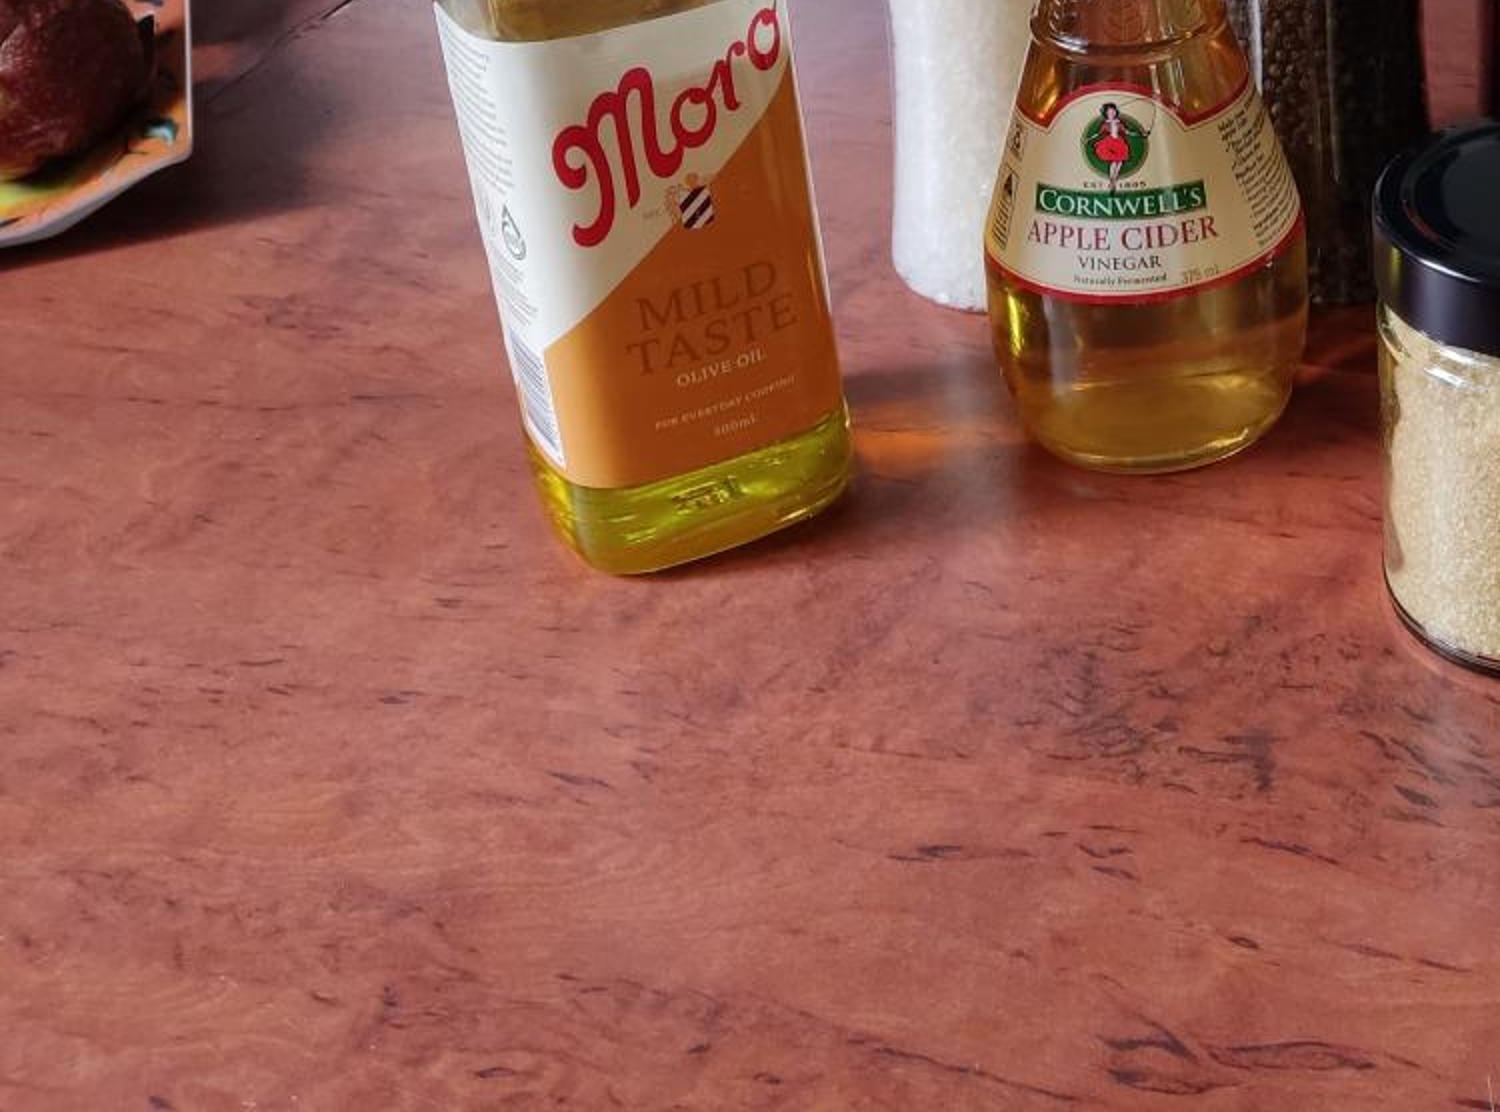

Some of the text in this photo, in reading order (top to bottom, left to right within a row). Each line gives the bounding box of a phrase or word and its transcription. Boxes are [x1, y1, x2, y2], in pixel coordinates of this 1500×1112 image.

[1027, 220, 1111, 252] APPLE
[1121, 214, 1219, 252] CIDER
[1078, 254, 1162, 271] VINEGAR
[634, 260, 777, 332] MILD
[625, 293, 800, 376] TASTE
[676, 348, 767, 387] OLIVE OIL
